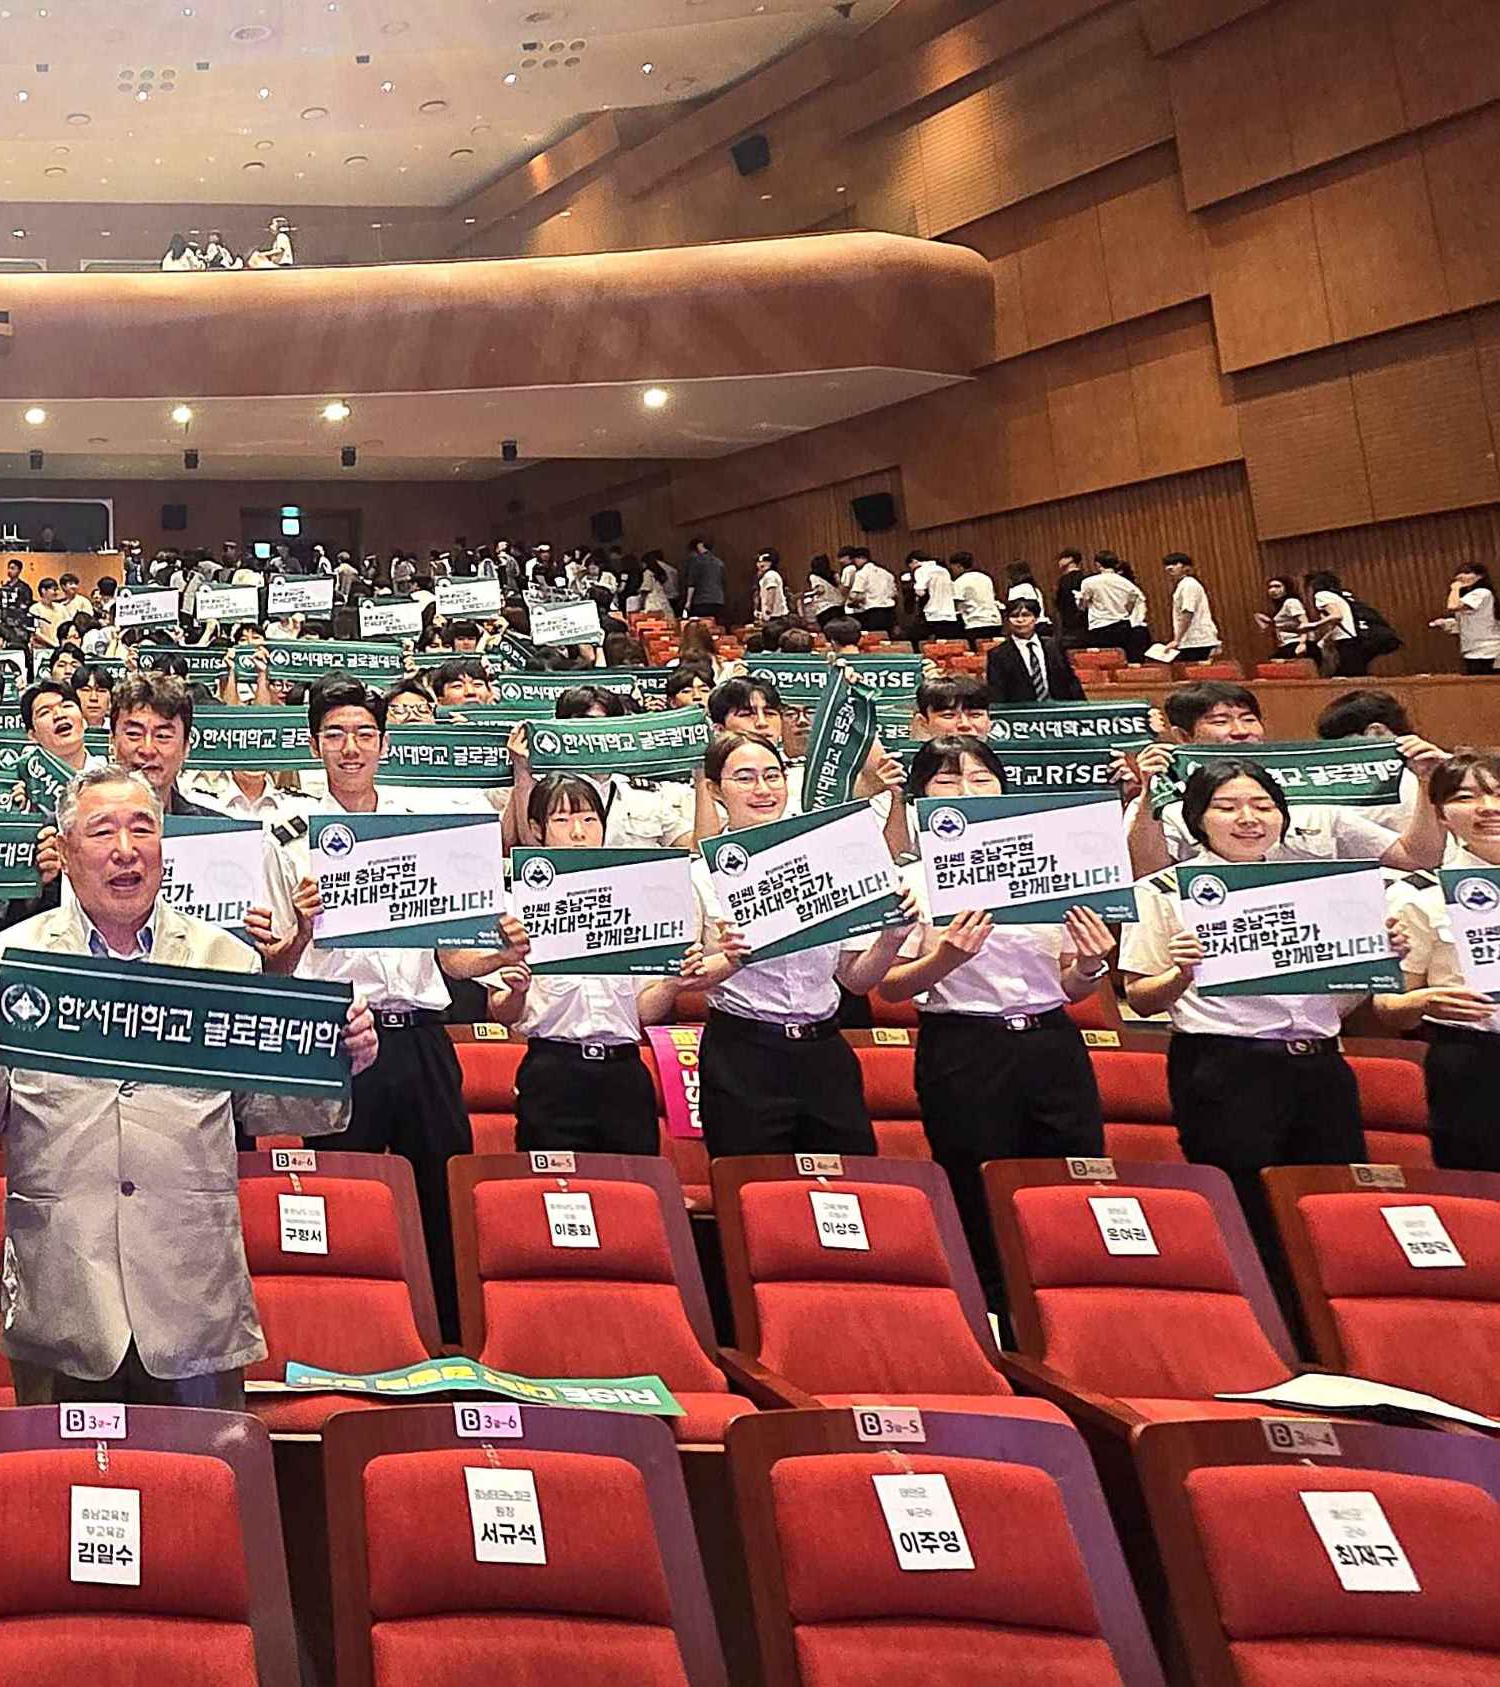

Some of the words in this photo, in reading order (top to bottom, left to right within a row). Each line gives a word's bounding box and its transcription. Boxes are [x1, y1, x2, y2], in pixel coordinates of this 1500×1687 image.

[203, 729, 276, 750] 한서대학교
[969, 841, 1034, 865] 충남구현
[355, 860, 416, 885] 충남구현
[757, 862, 811, 896] 충남구현
[936, 854, 1058, 890] 한서대학교가
[1007, 865, 1121, 899] 함께합니다!
[321, 876, 438, 911] 한서대학교가
[389, 890, 494, 922] 함께합니다!
[555, 894, 612, 916] 충남구현
[734, 872, 834, 927] 한서대학교가
[796, 871, 891, 922] 함께합니다!
[524, 907, 631, 938] 한서대학교가
[586, 920, 684, 950] 함께합니다!
[1232, 909, 1296, 933] 충남구현
[1202, 922, 1320, 959] 한서대학교가
[1272, 934, 1384, 968] 함께합니다!
[57, 995, 193, 1044] 한서대학교
[203, 1011, 341, 1058] 글로컬대학
[562, 1386, 662, 1406] RISE
[68, 1410, 83, 1431] B
[464, 1409, 479, 1430] B
[862, 1413, 880, 1434] B
[481, 1522, 536, 1548] 서규석
[900, 1530, 960, 1554] 이주영
[77, 1542, 134, 1566] 김일수
